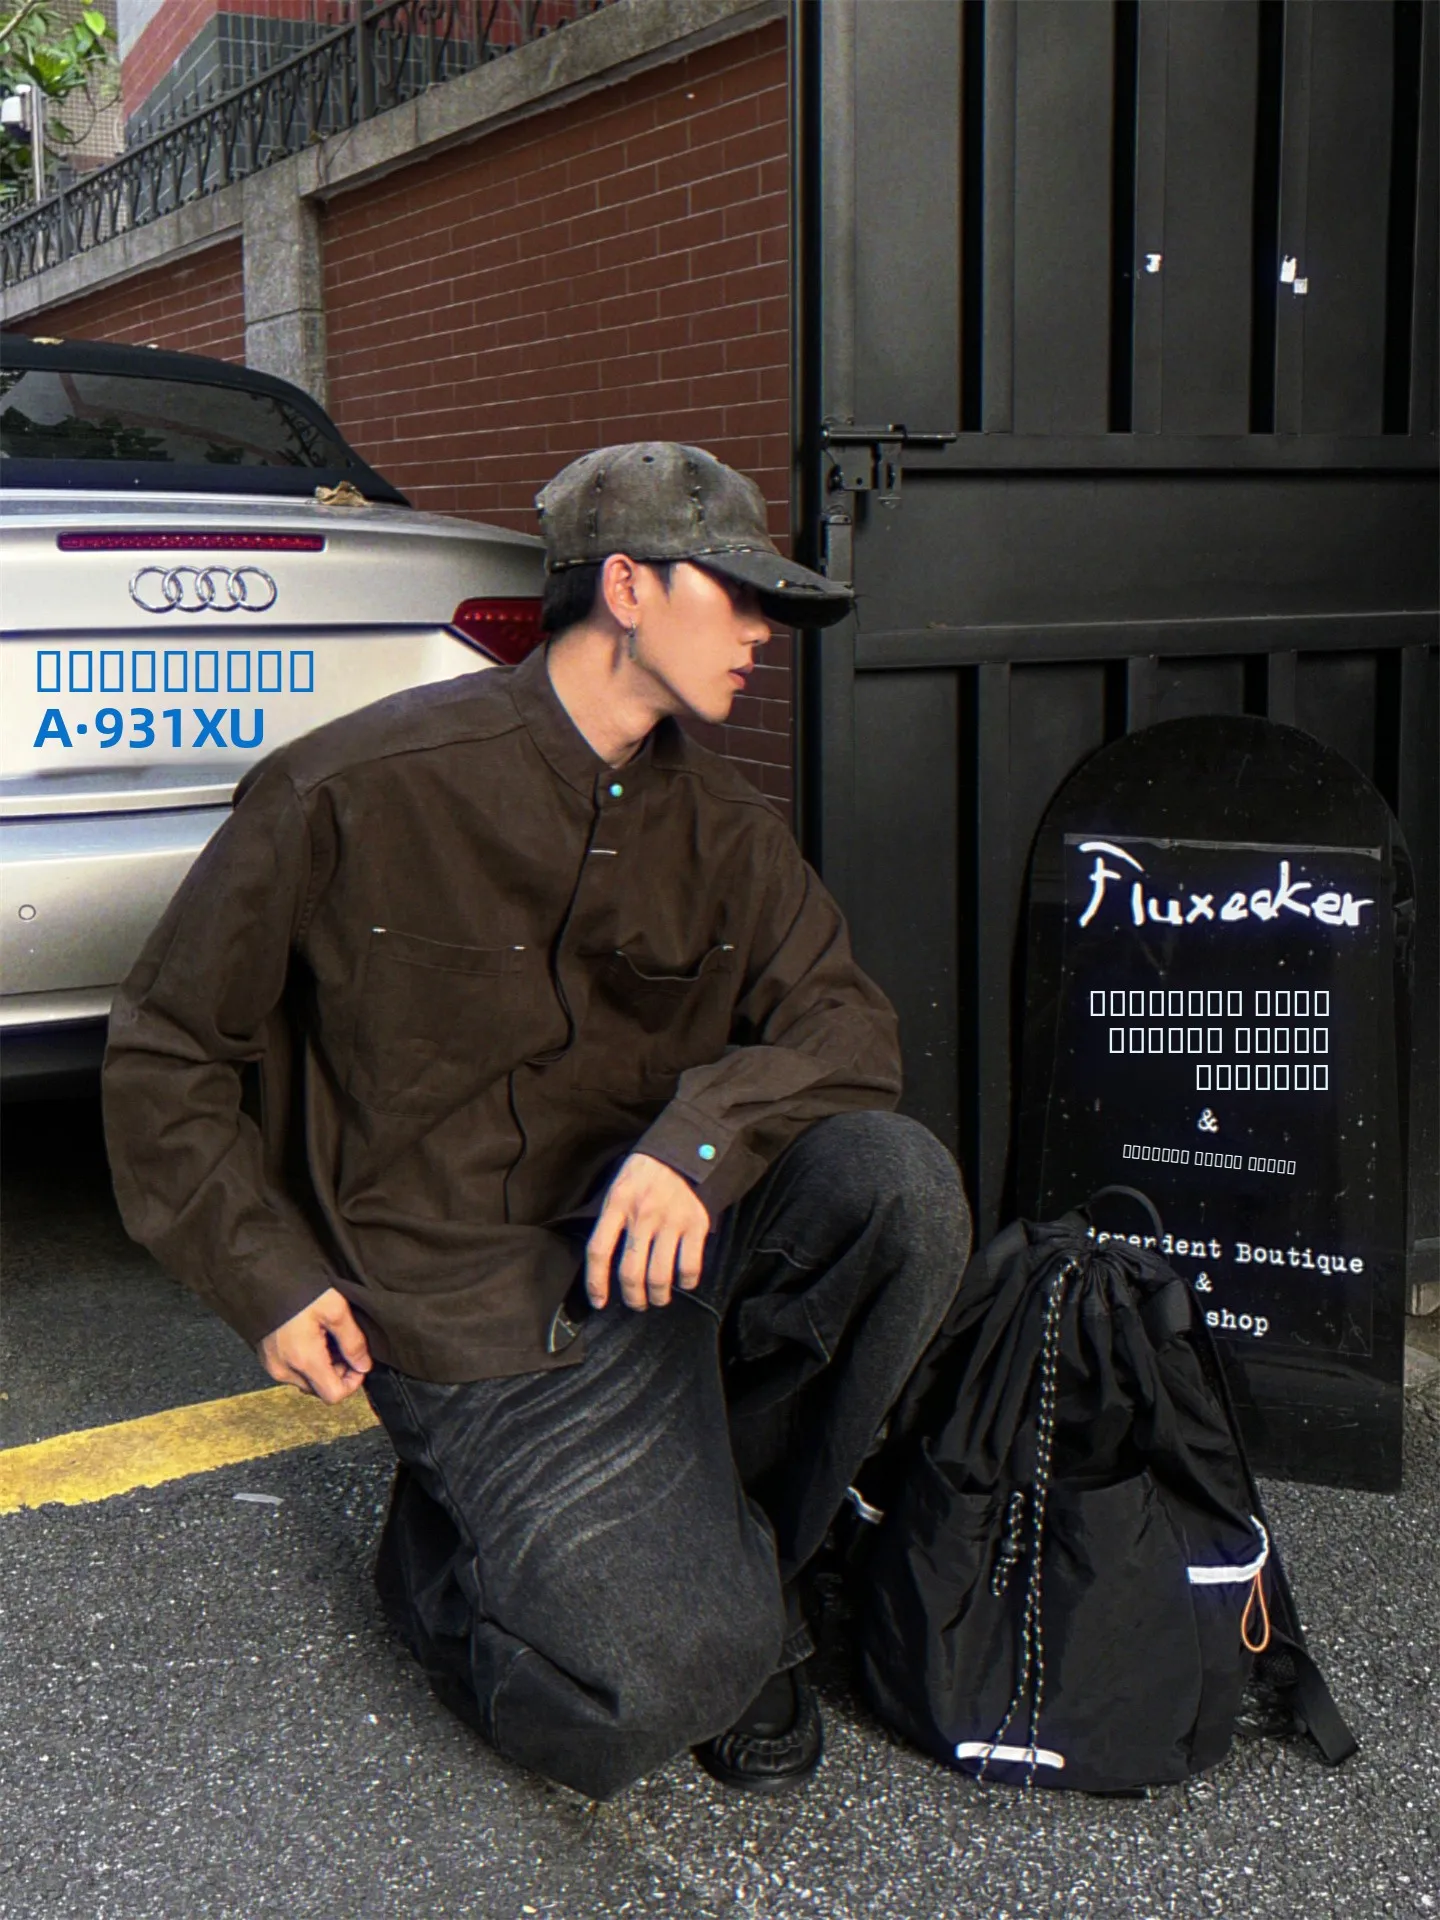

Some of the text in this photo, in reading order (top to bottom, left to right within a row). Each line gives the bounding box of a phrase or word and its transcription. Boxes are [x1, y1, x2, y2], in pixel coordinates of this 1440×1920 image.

[1197, 1107, 1220, 1133] &
[1235, 1242, 1365, 1275] Boutique
[1194, 1271, 1213, 1293] &
[1205, 1308, 1269, 1337] shop
